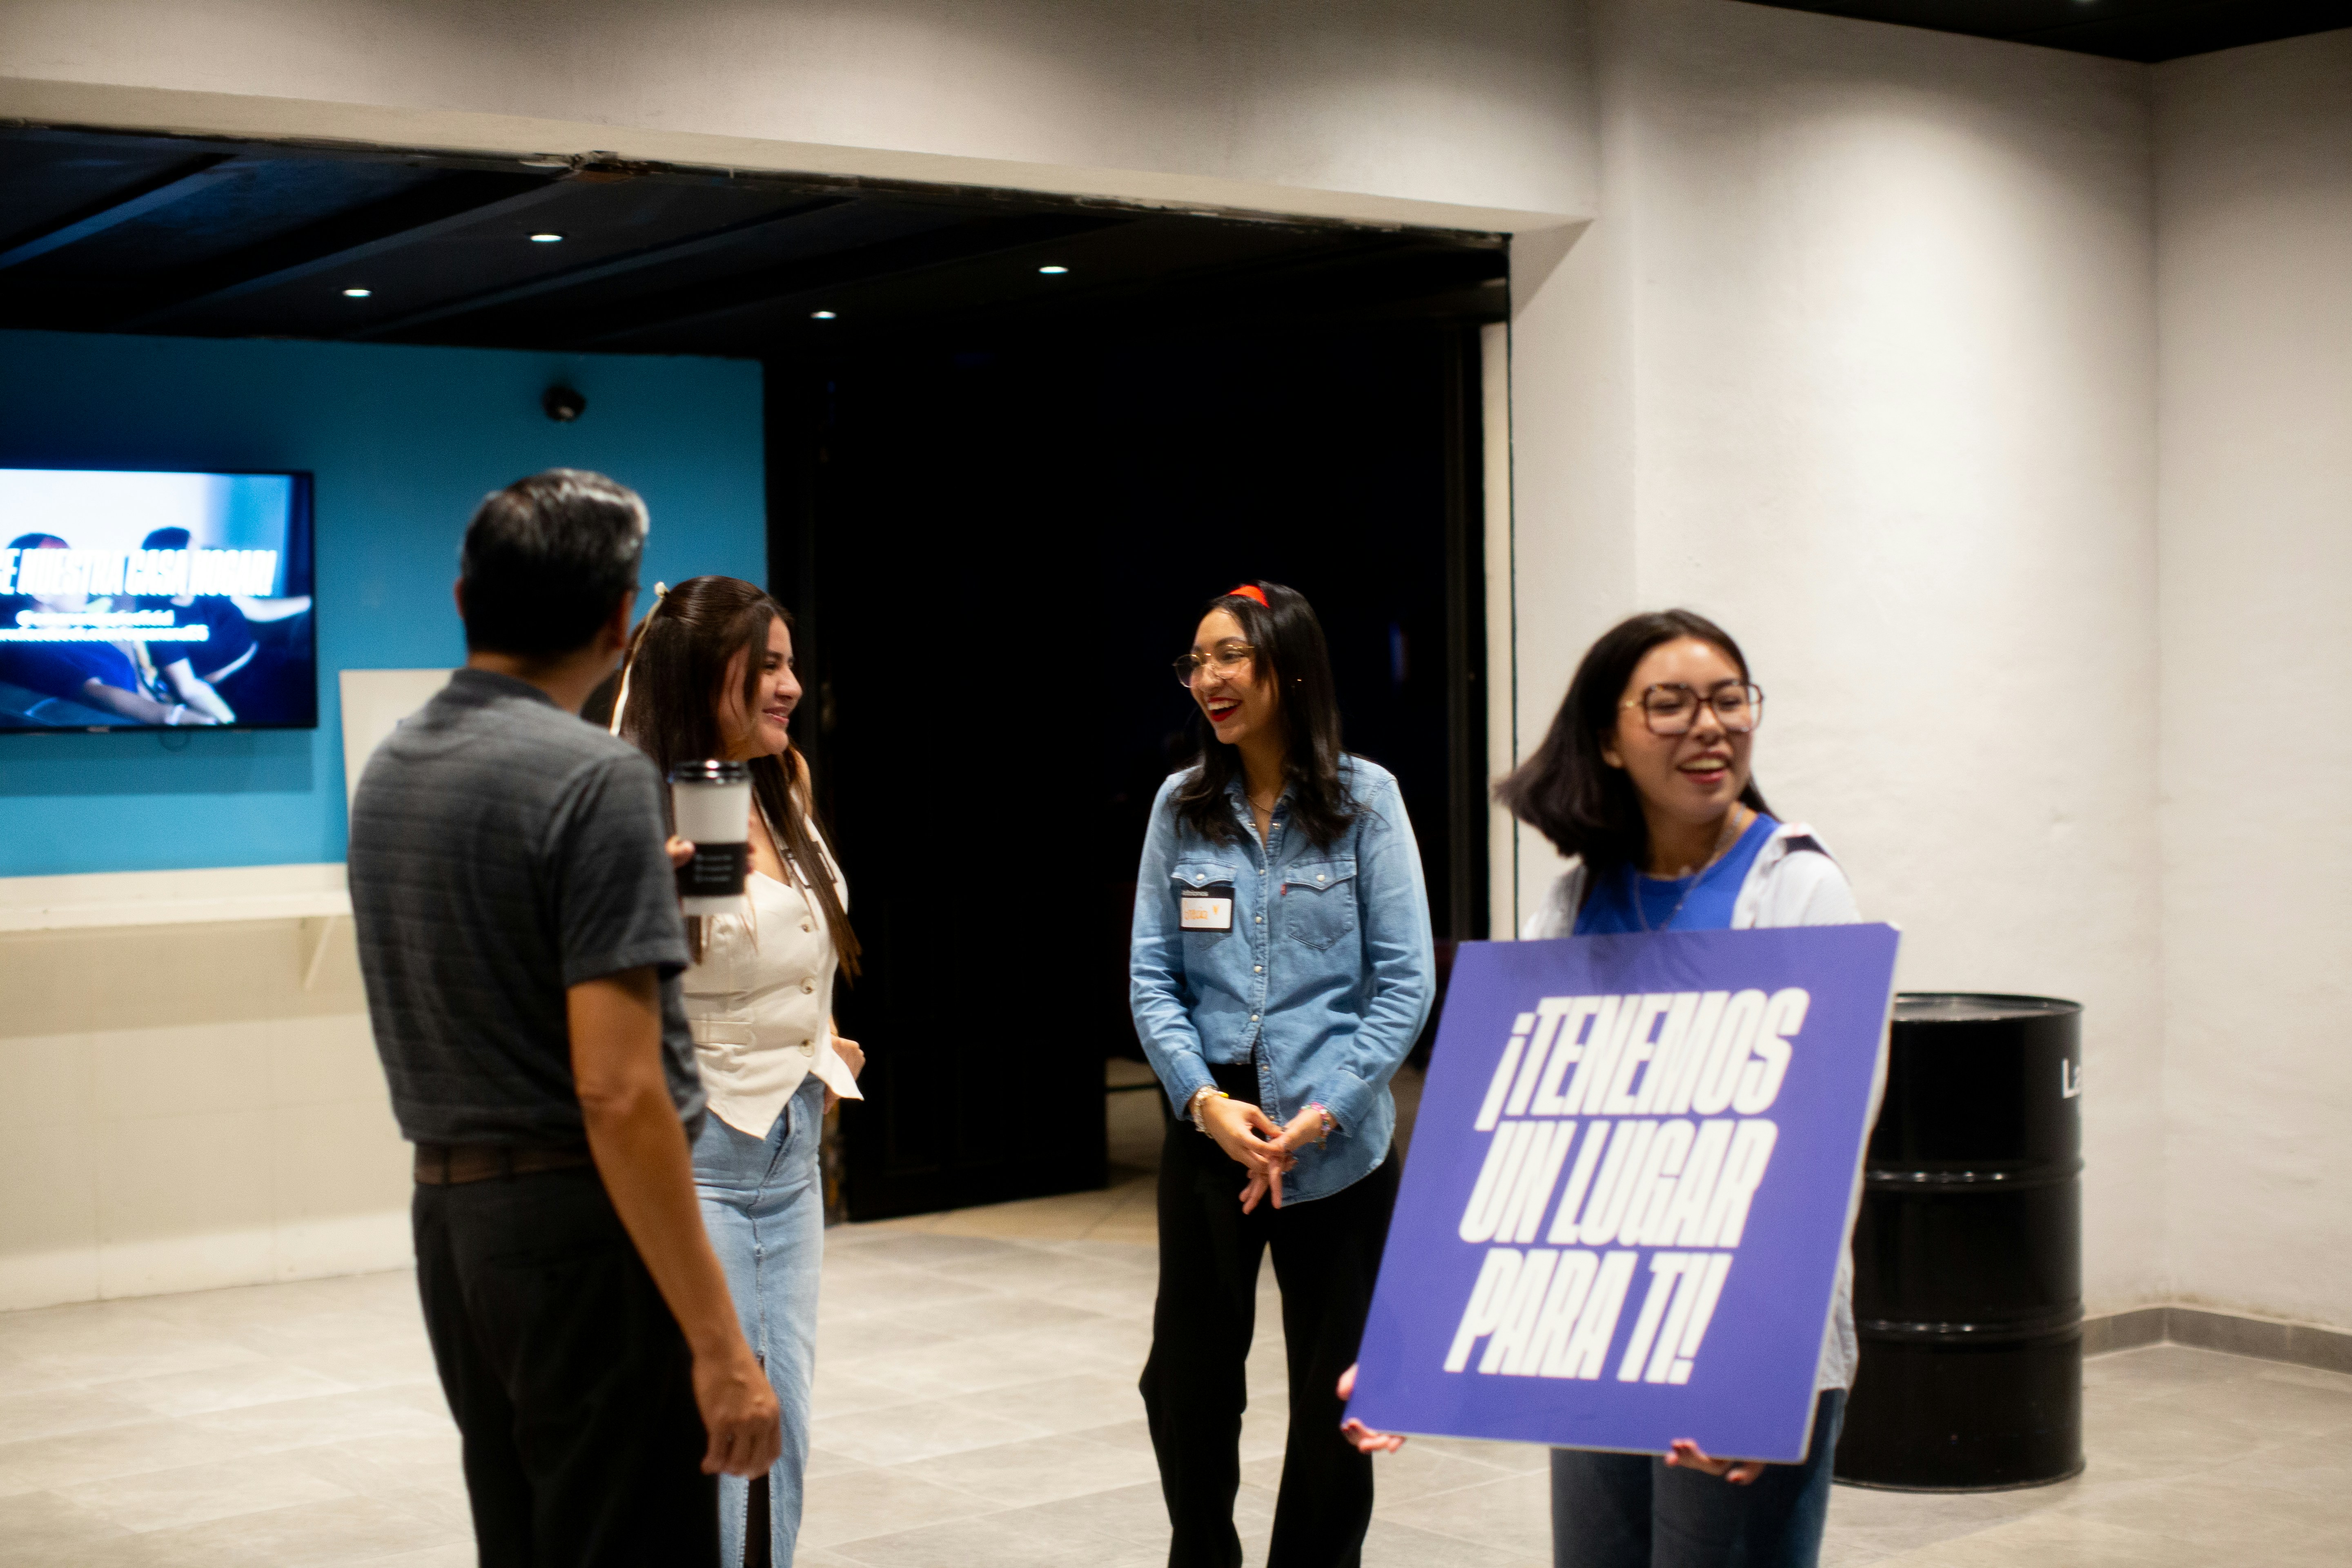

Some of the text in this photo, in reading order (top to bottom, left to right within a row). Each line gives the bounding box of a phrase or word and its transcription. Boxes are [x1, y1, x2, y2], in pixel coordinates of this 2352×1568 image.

[16, 549, 125, 596] NUESTRA
[124, 549, 189, 596] CASA
[1474, 987, 1811, 1131] ¡TENEMOS
[1459, 1118, 1779, 1249] UN LUGAR
[1443, 1247, 1734, 1385] PARA TI!
